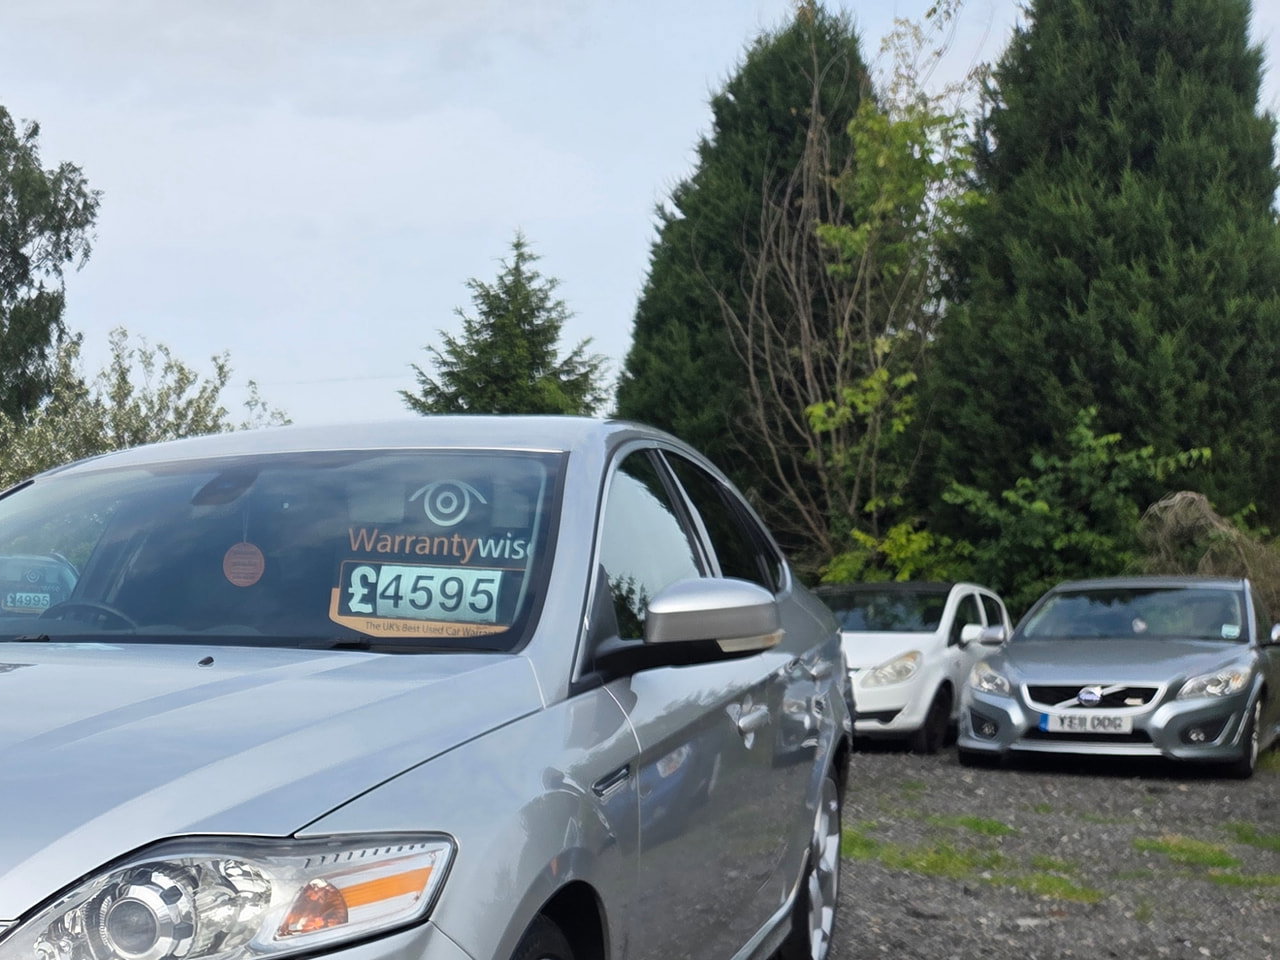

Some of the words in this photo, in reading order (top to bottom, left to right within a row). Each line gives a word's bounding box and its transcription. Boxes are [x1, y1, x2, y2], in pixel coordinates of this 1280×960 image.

[348, 565, 495, 614] £4595
[365, 621, 381, 630] The
[401, 623, 420, 633] Best
[422, 624, 444, 634] Used
[445, 626, 460, 636] Car
